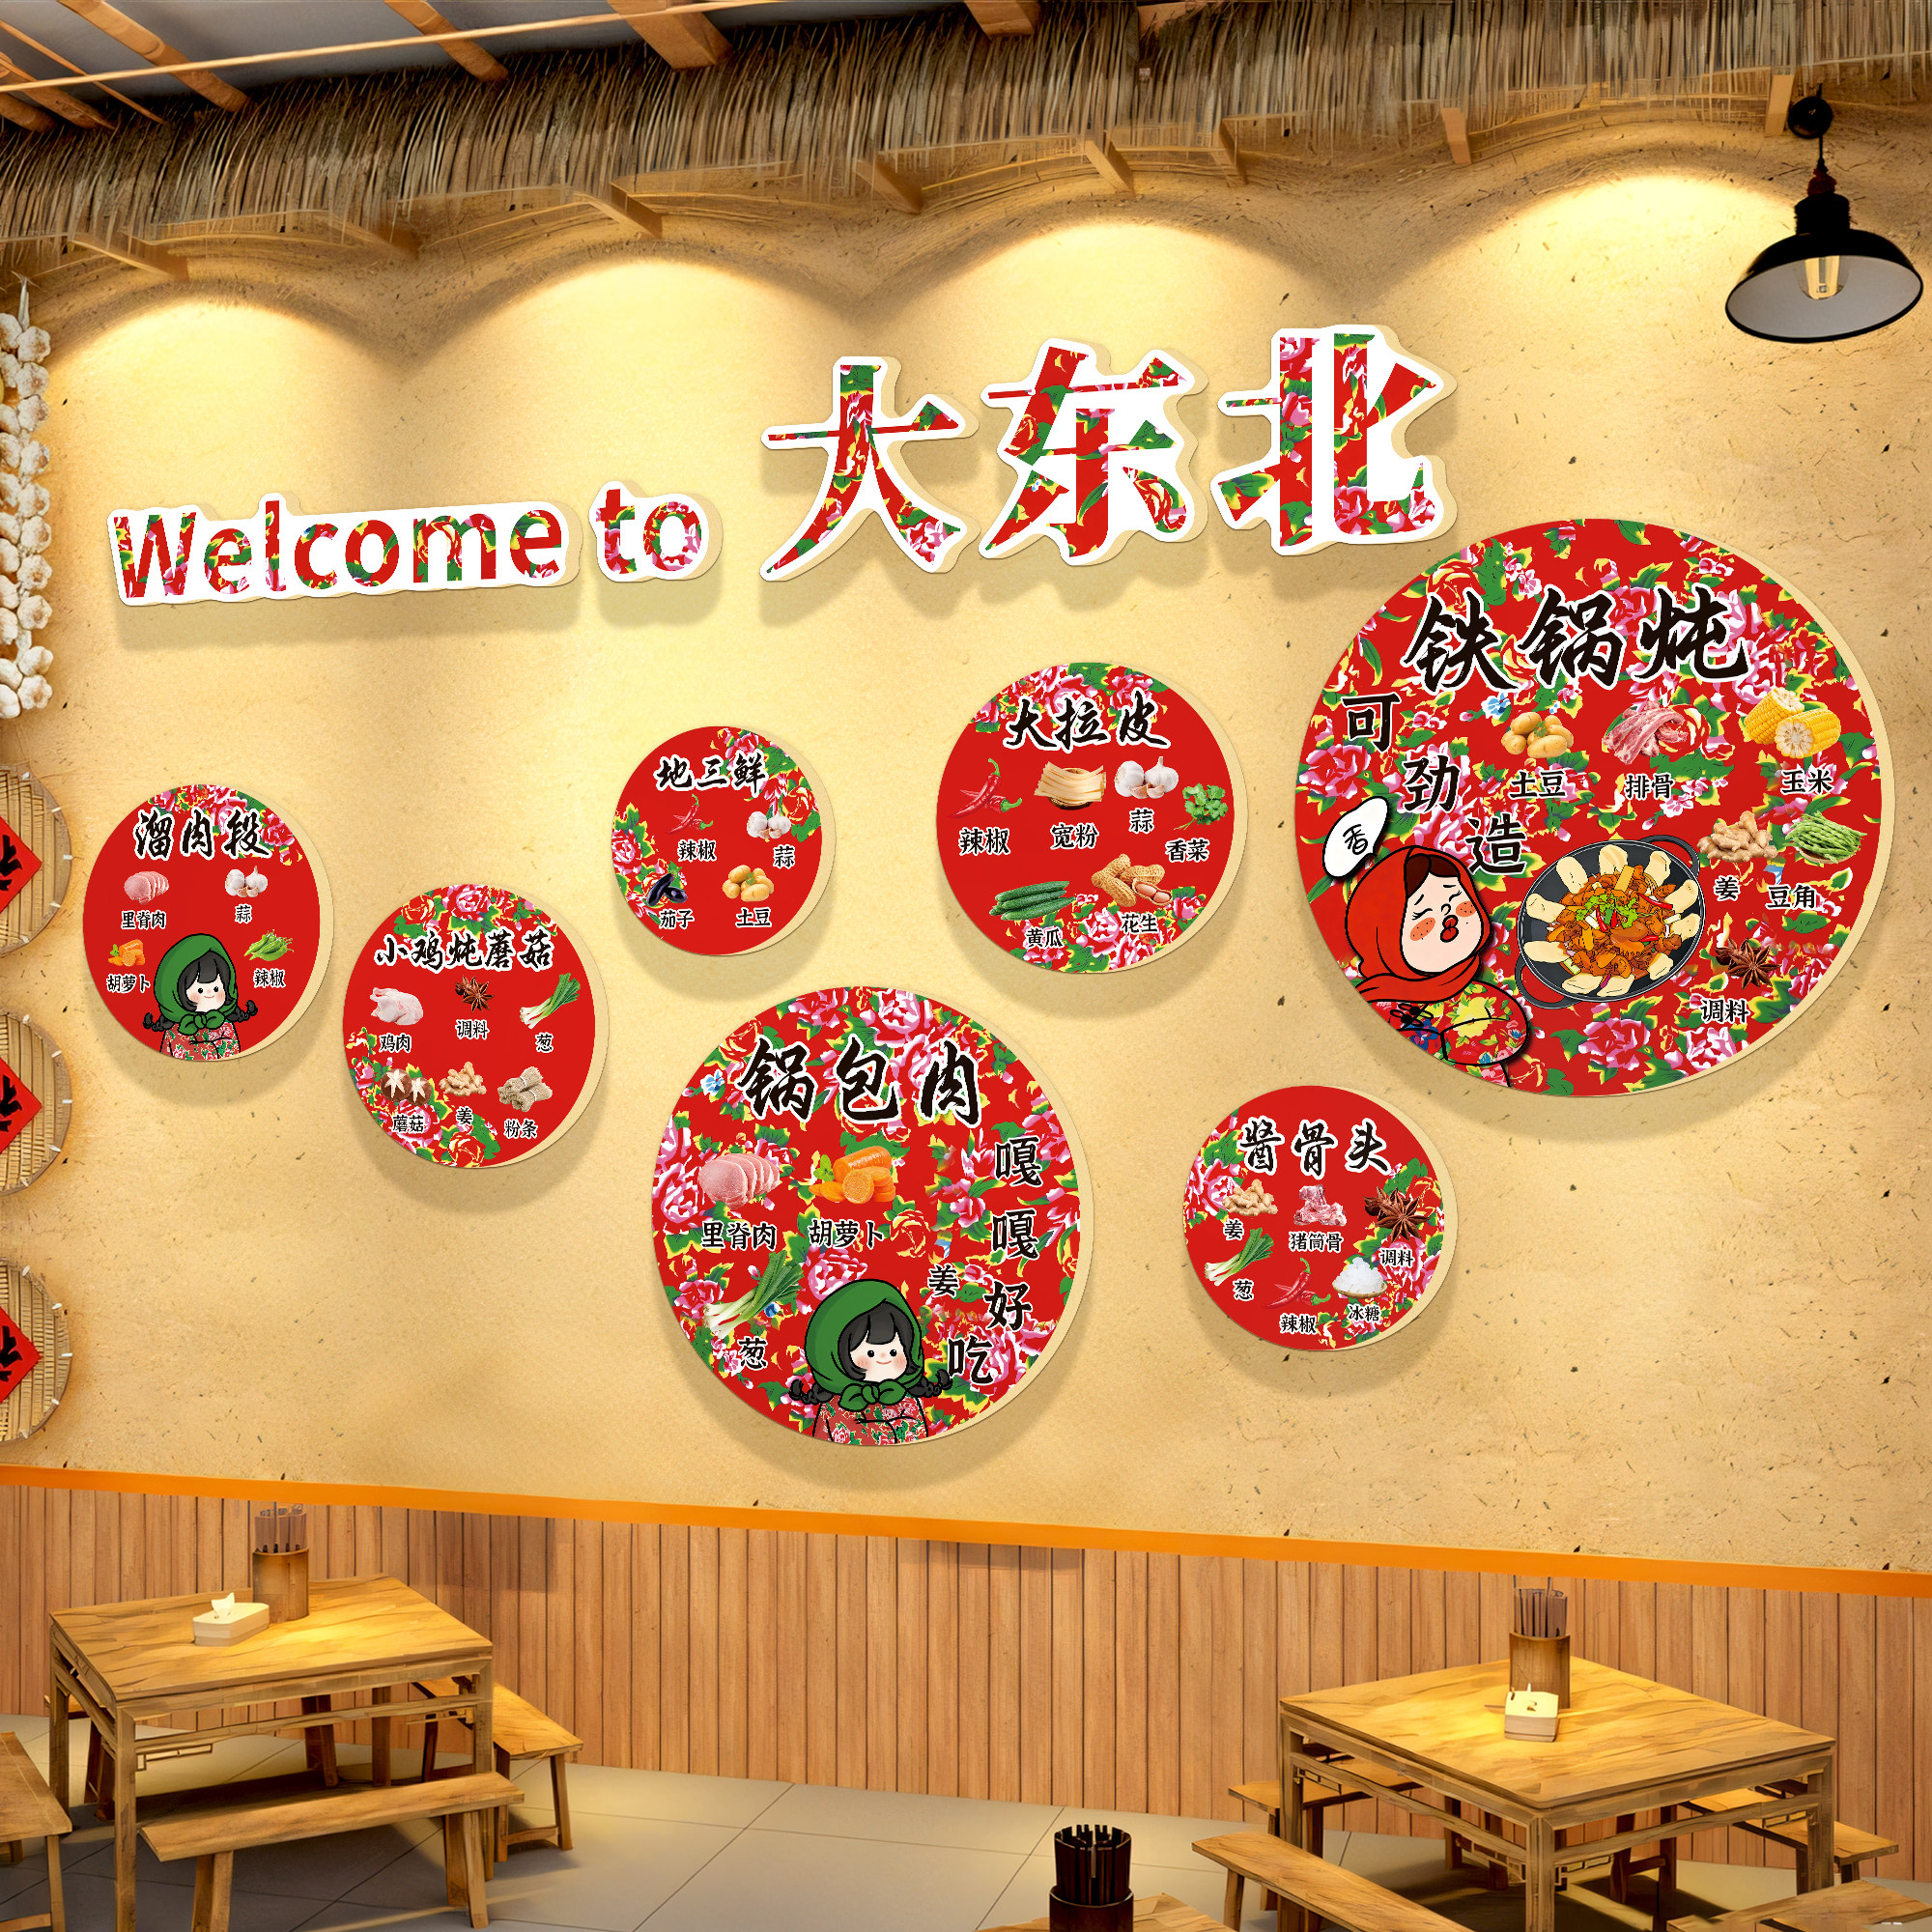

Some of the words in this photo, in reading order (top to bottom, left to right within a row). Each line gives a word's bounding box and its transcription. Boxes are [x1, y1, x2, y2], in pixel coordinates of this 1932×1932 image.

[113, 500, 562, 598] Welcome
[596, 489, 702, 574] to
[767, 333, 1438, 575] 大东北
[1403, 585, 1748, 693] 铁锅炖
[1006, 690, 1168, 751] 大拉皮
[656, 752, 766, 794] 地三鲜
[1509, 770, 1566, 799] 土豆
[1781, 769, 1833, 794] 玉米
[1625, 774, 1674, 799] 排骨
[1130, 809, 1153, 833] 蒜
[135, 809, 270, 859] 溜肉段
[960, 828, 1009, 855] 辣椒
[1051, 823, 1098, 848] 宽粉
[678, 839, 716, 861] 辣椒
[774, 845, 795, 867] 蒜
[1166, 838, 1208, 862] 香菜
[1715, 876, 1739, 900] 姜
[1767, 884, 1815, 909] 豆角
[122, 911, 166, 929] 里脊肉
[236, 904, 251, 923] 蒜
[660, 910, 694, 928] 茄子
[736, 908, 771, 926] 土豆
[1121, 913, 1158, 933] 花生
[376, 928, 552, 971] 小鸡炖蘑菇
[1026, 927, 1064, 948] 黄瓜
[107, 975, 150, 992] 胡萝卜
[254, 969, 285, 987] 辣椒
[1699, 999, 1749, 1023] 调料
[456, 1020, 488, 1038] 调料
[380, 1034, 411, 1052] 鸡肉
[536, 1034, 553, 1052] 葱
[737, 1037, 980, 1125] 锅包肉
[393, 1114, 424, 1132] 蘑菇
[456, 1107, 473, 1124] 姜
[505, 1120, 537, 1138] 粉条
[1239, 1119, 1388, 1177] 酱骨头
[701, 1221, 777, 1250] 里脊肉
[809, 1219, 883, 1249] 胡萝卜
[1224, 1219, 1243, 1239] 姜
[1291, 1233, 1343, 1252] 猪筒骨
[944, 1136, 1042, 1384] 嘎嘎好吃
[1379, 1249, 1413, 1267] 调料
[928, 1264, 959, 1296] 姜
[1234, 1280, 1253, 1300] 葱
[1281, 1315, 1317, 1333] 辣椒
[1348, 1305, 1380, 1321] 冰糖
[738, 1337, 767, 1370] 葱
